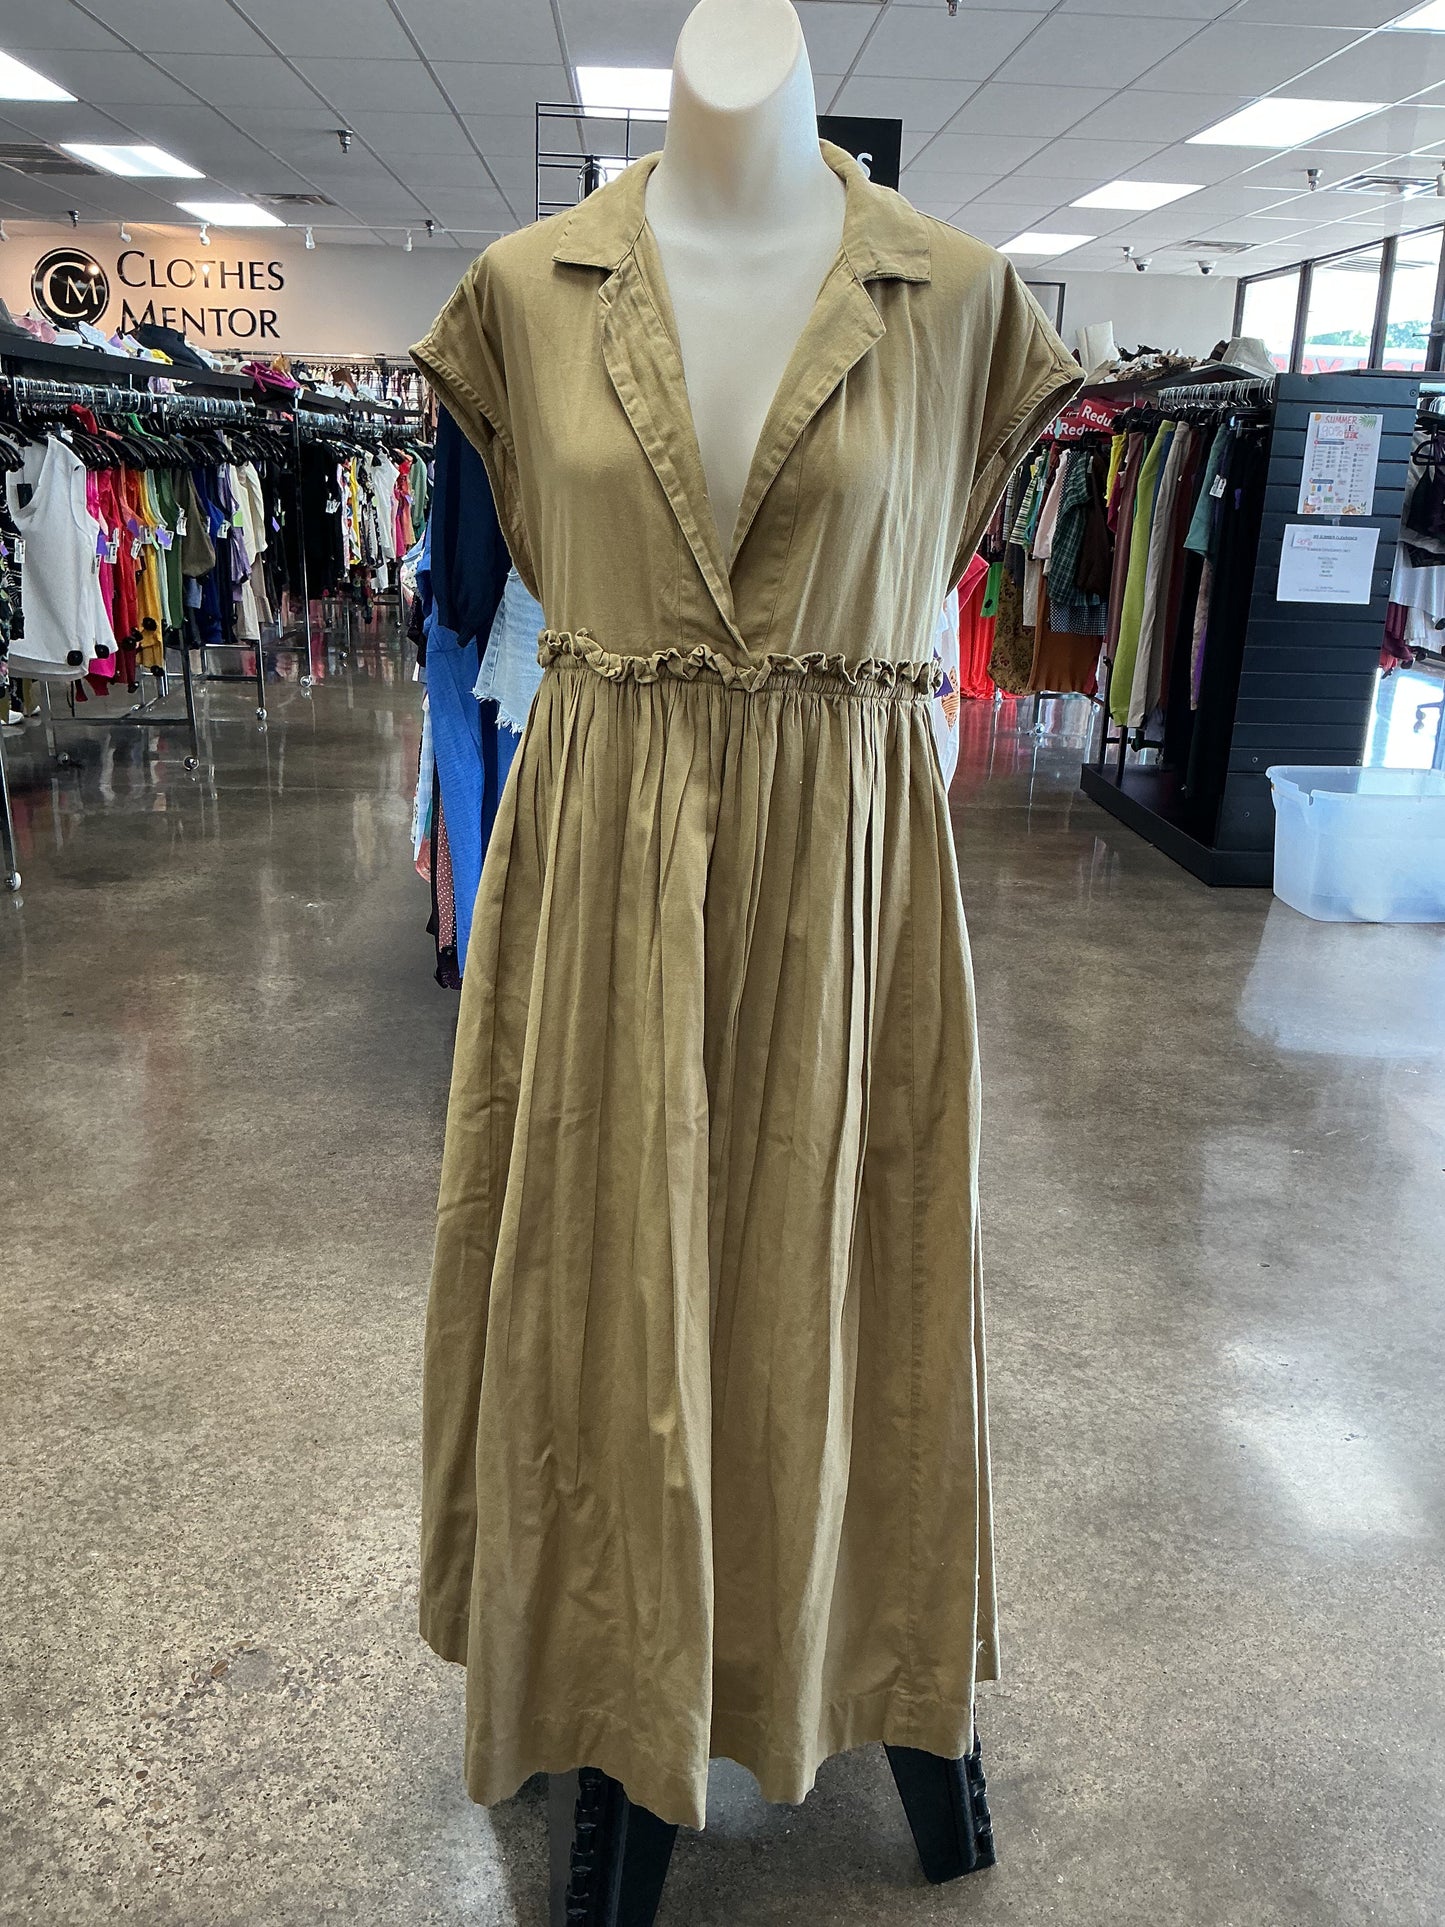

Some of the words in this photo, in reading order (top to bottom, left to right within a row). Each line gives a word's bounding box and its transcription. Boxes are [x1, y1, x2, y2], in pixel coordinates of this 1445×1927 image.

[117, 250, 284, 291] CLOTHES
[121, 299, 280, 338] MENTOR
[1325, 415, 1358, 425] SUMMER
